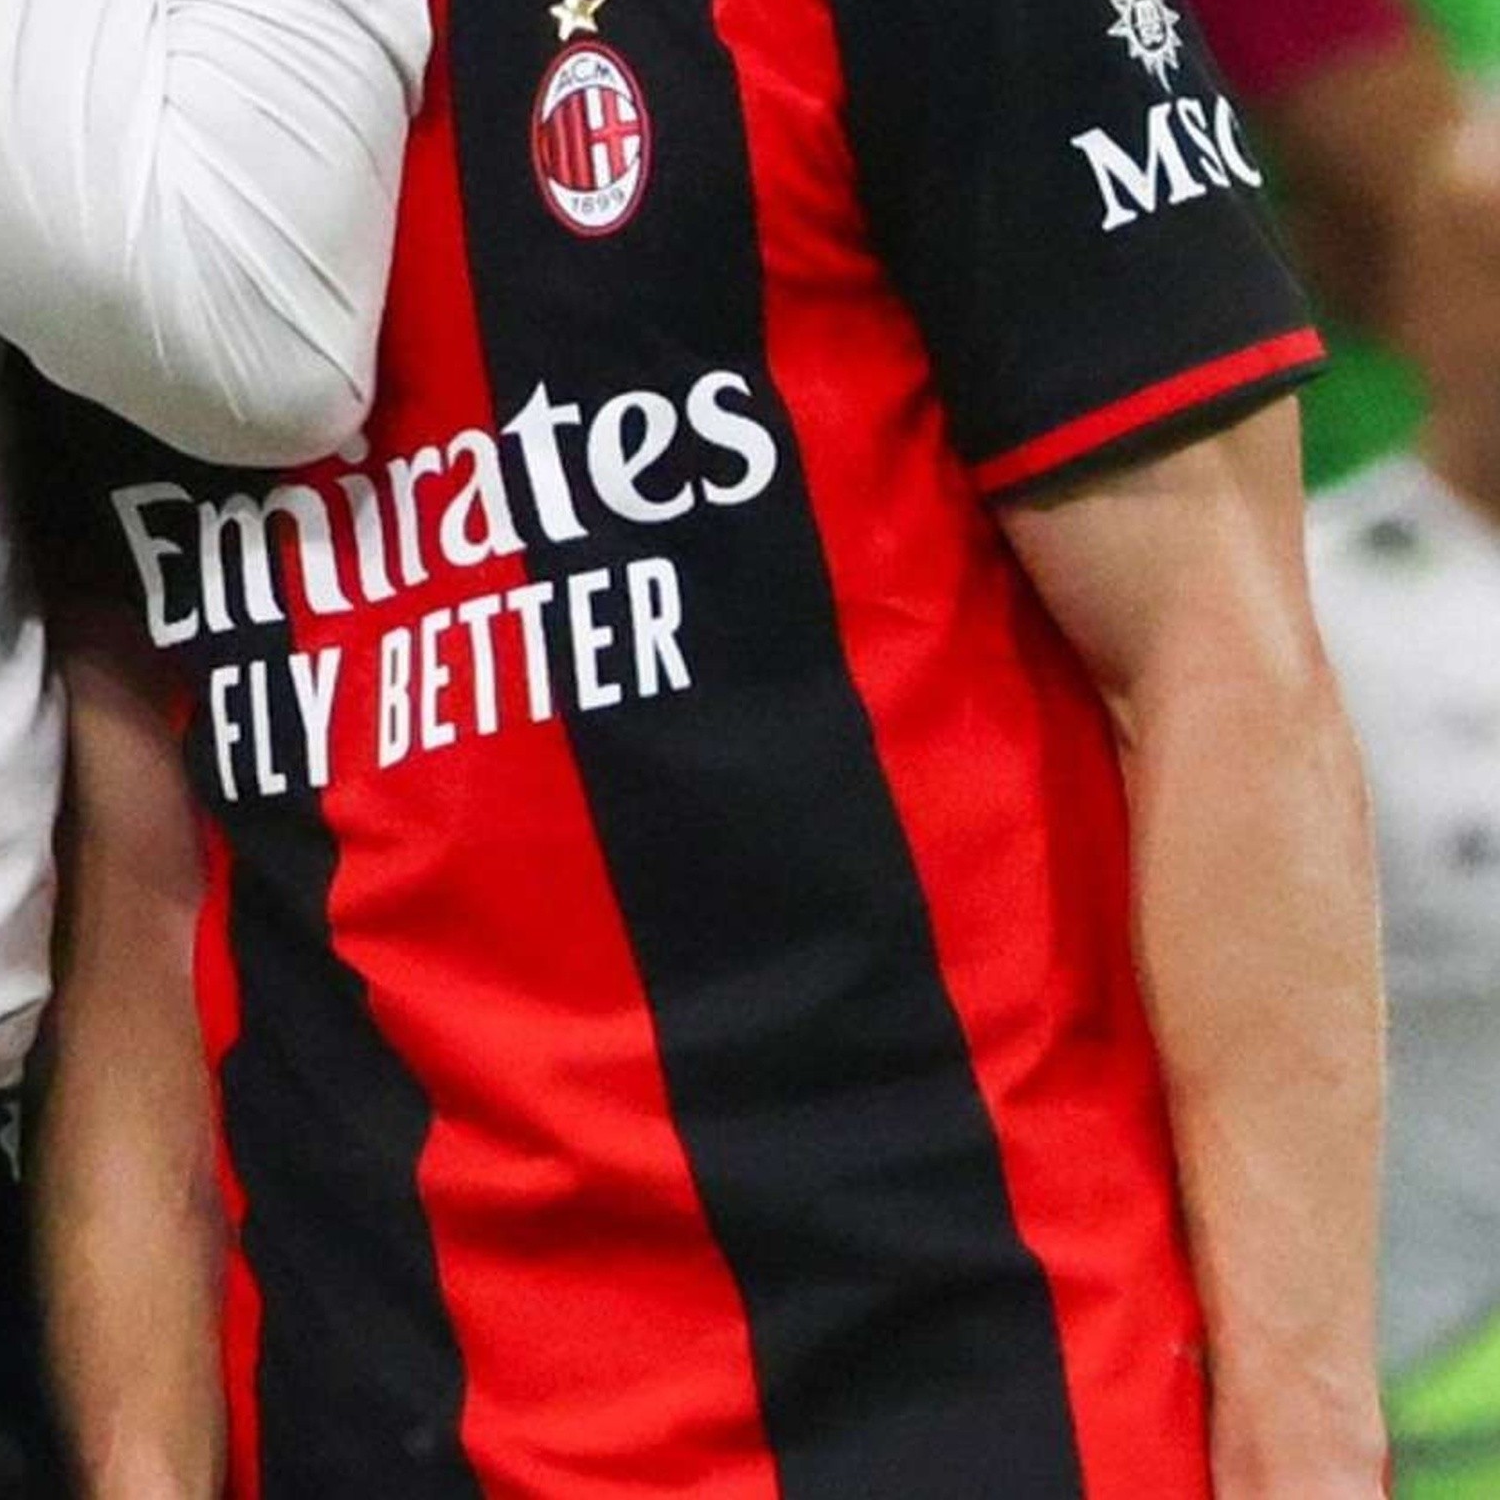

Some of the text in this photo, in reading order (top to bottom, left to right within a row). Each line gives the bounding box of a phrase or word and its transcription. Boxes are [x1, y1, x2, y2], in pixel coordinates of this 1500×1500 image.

[557, 57, 615, 94] ACM
[570, 189, 626, 215] 1899
[1069, 94, 1263, 231] MSC
[110, 369, 778, 649] Emirates
[208, 556, 692, 802] FLY BETTER
